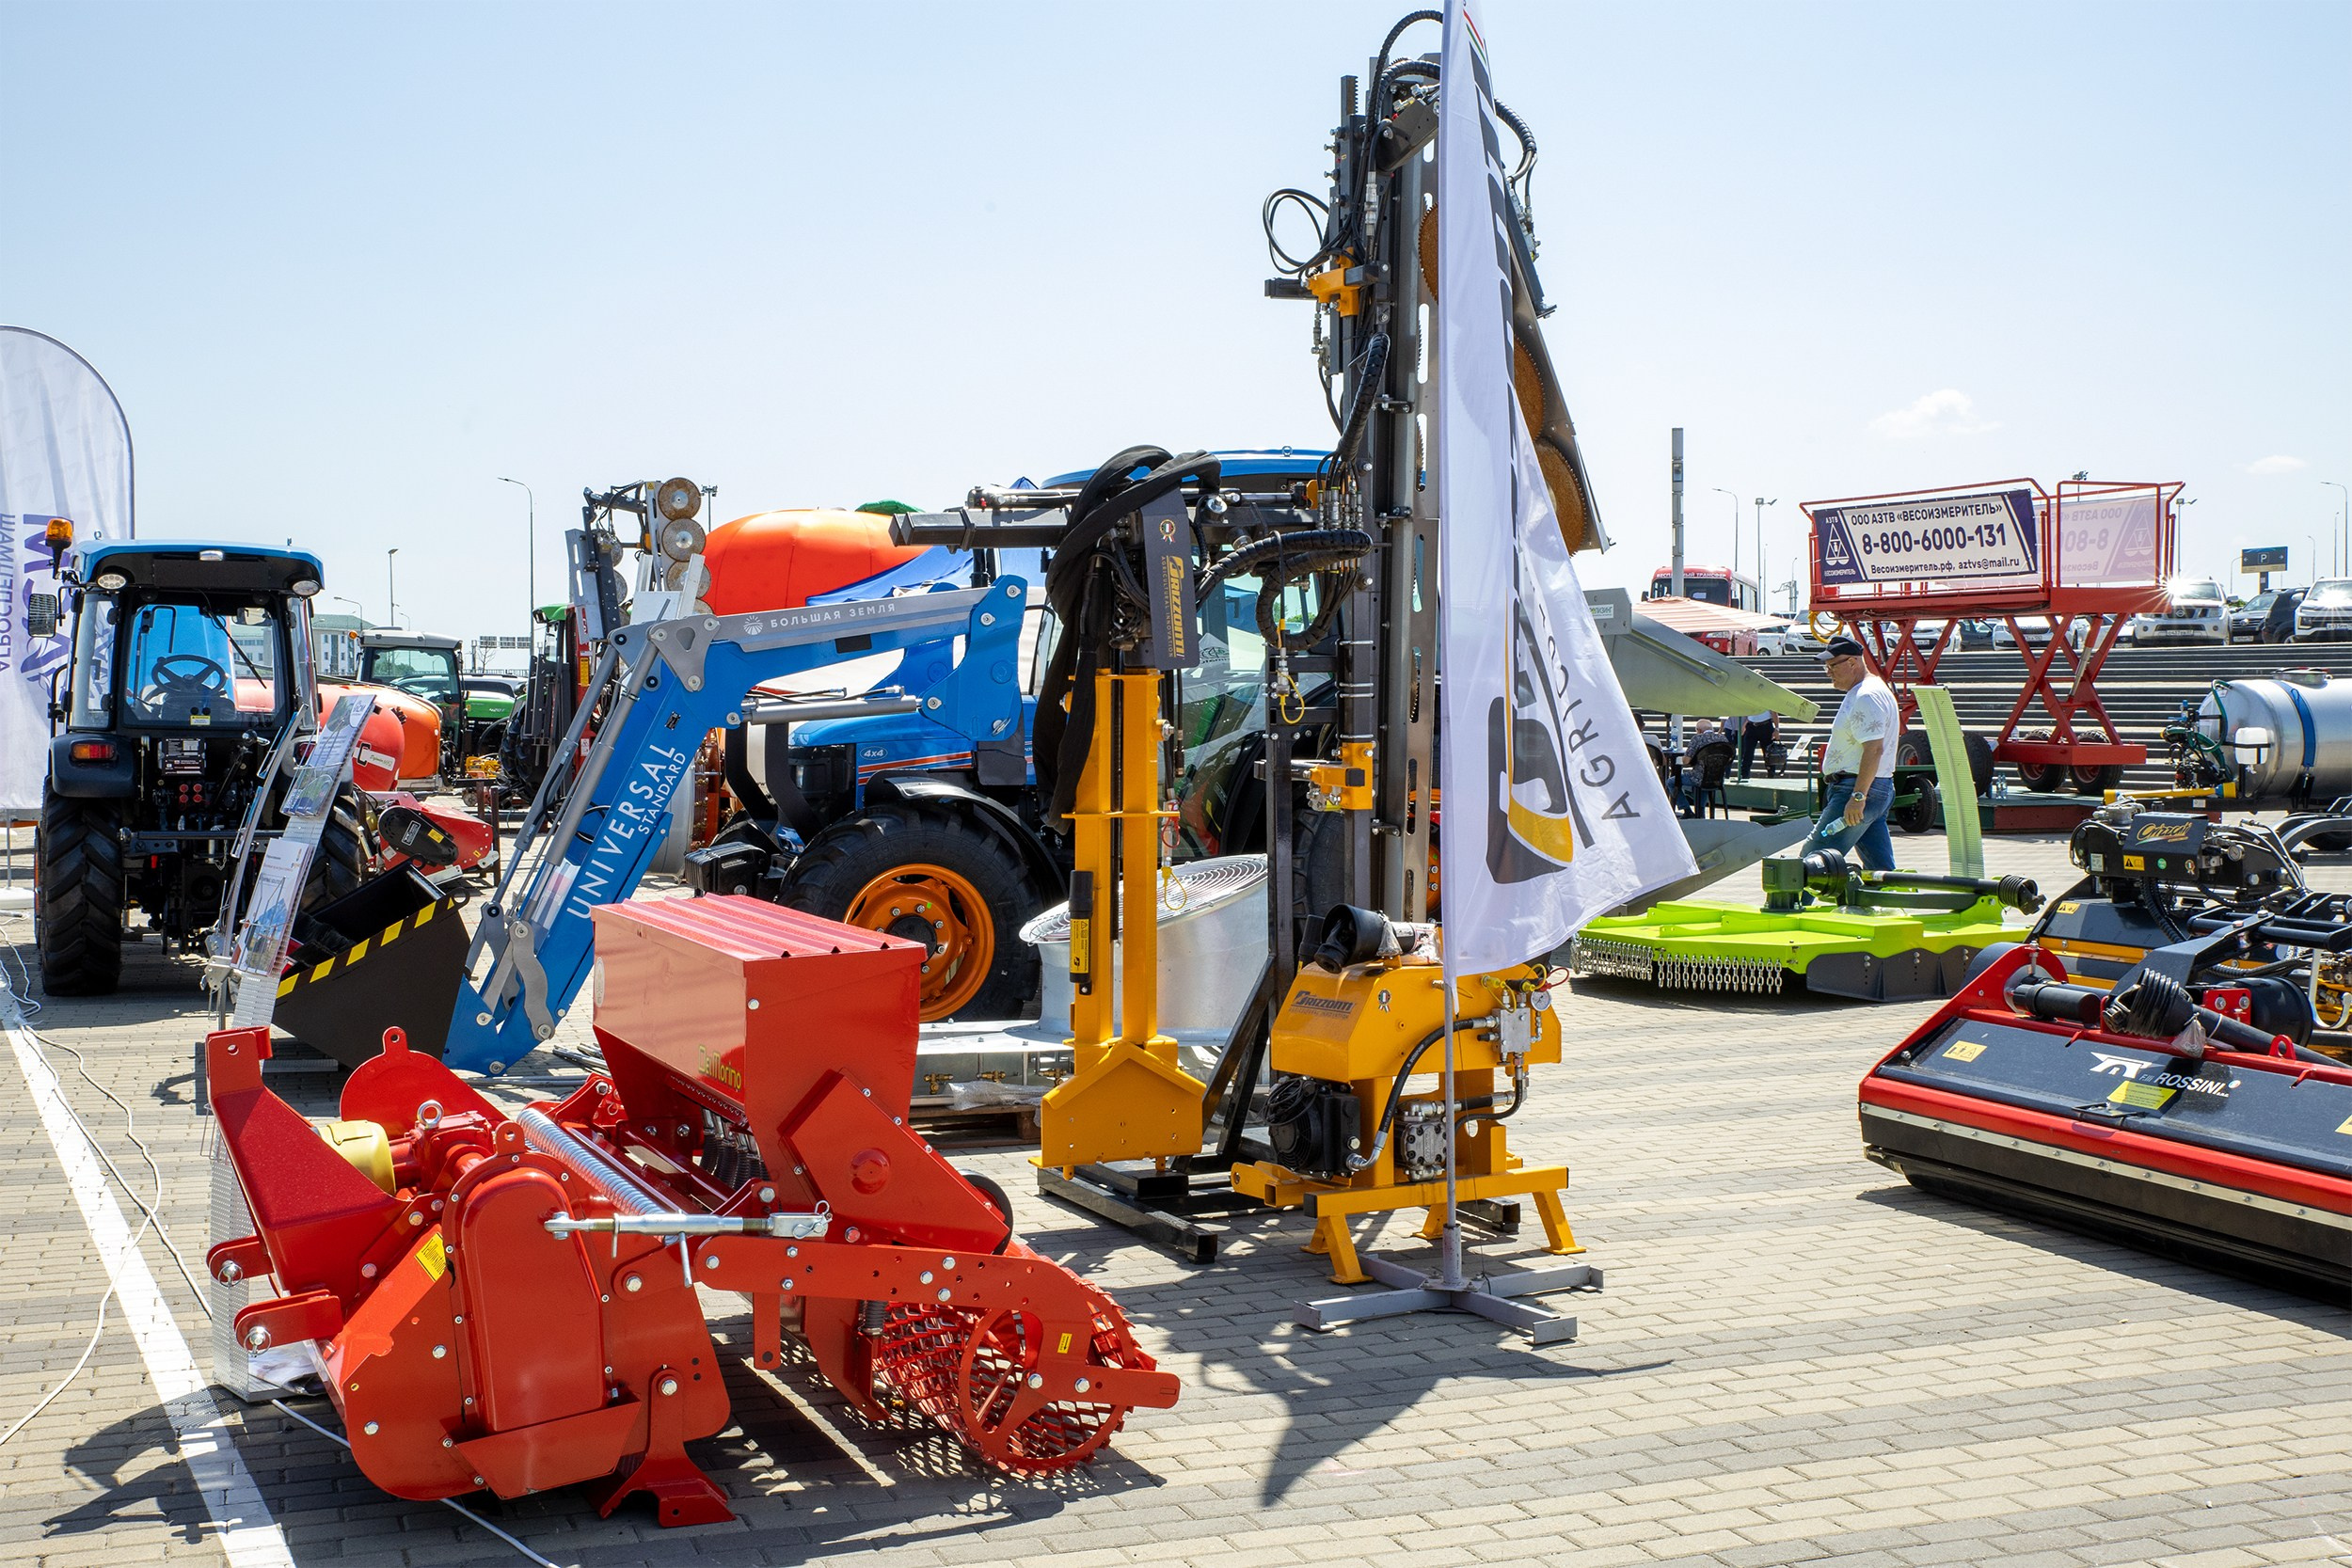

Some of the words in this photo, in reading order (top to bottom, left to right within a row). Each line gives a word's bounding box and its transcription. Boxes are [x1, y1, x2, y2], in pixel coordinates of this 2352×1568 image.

[1851, 513, 1869, 526] ООО
[1871, 510, 1896, 524] АЗТВ
[1897, 502, 2003, 522] «ВЕСОИЗМЕРИТЕЛЬ»
[1862, 523, 2007, 555] 8-800-6000-131
[1958, 557, 2020, 570] aztvs@mail.ru
[771, 610, 841, 628] БОЛЬШАЯ
[849, 603, 896, 617] ЗЕМЛЯ
[1166, 612, 1174, 657] INNOVATION
[638, 752, 686, 834] STANDARD
[566, 744, 675, 919] UNIVERSAL
[2153, 1071, 2226, 1096] ROSSINI
